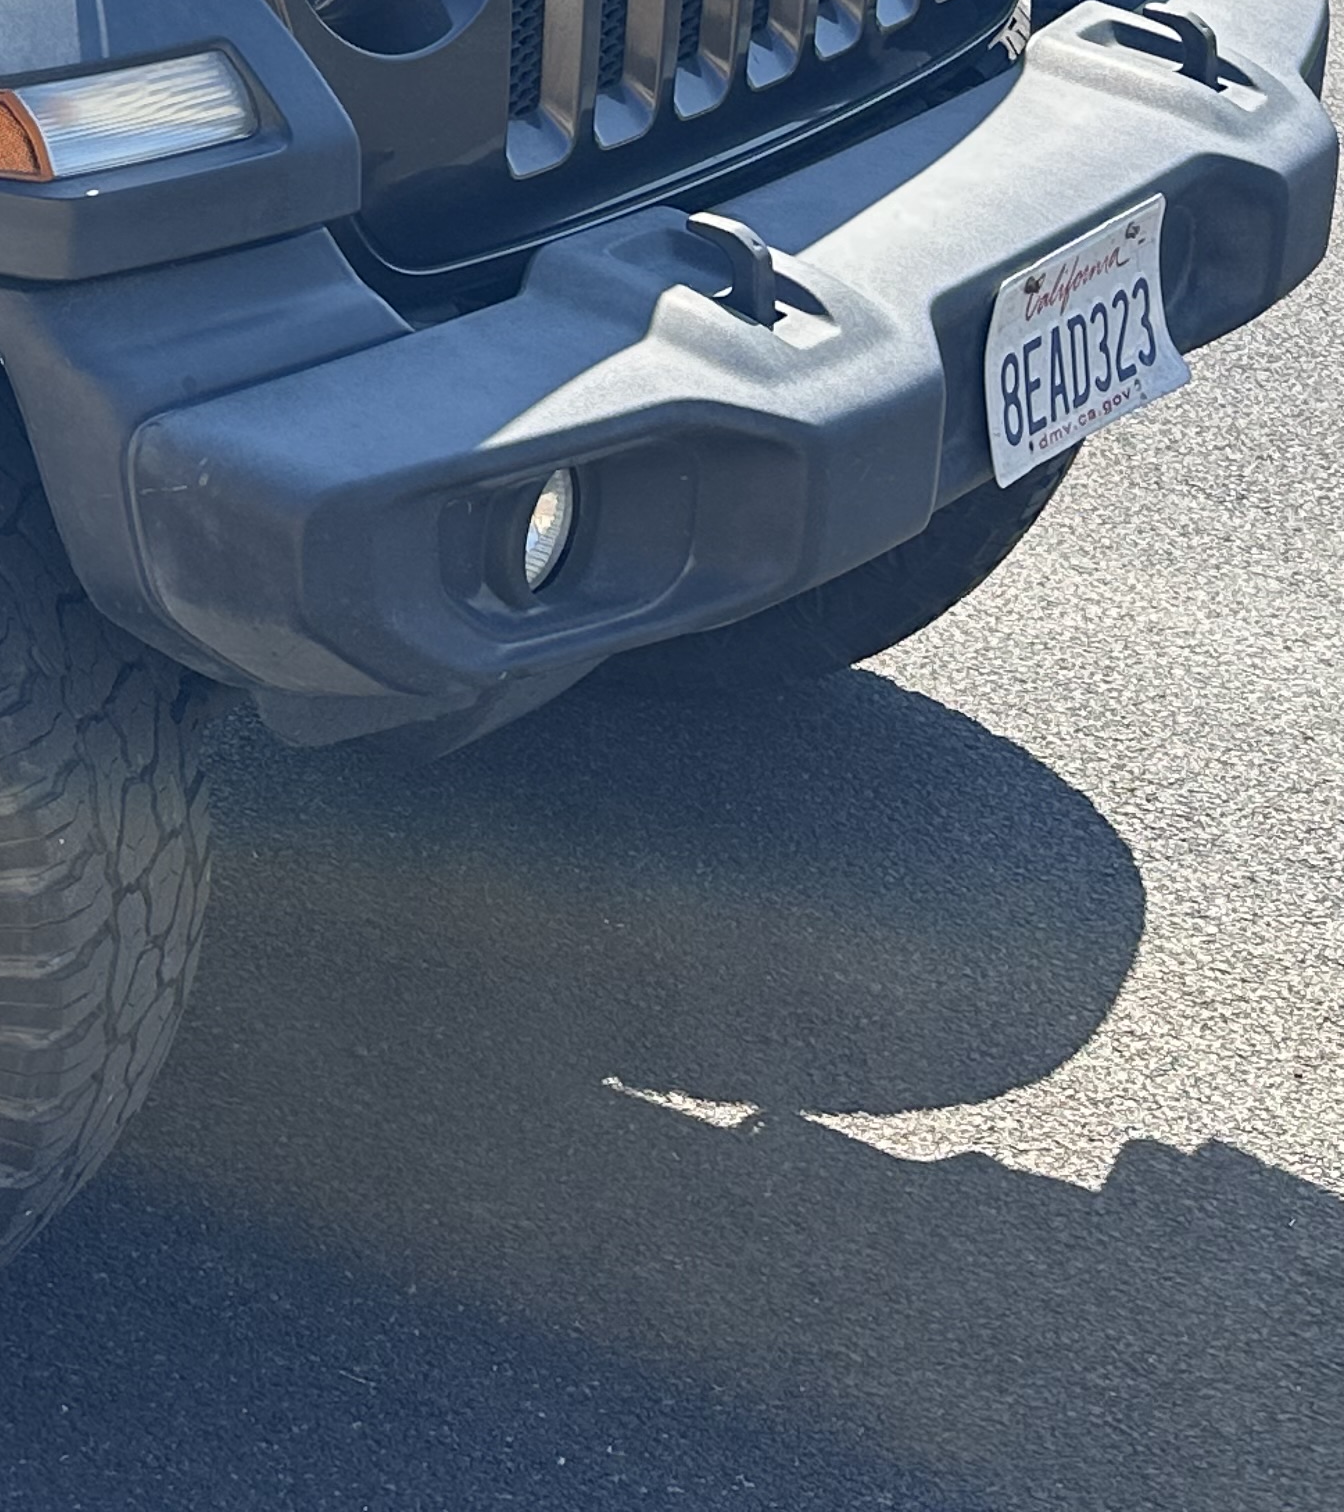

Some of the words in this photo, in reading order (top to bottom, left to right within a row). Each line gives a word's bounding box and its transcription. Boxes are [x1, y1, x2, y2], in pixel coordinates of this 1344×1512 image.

[1024, 246, 1131, 322] California
[1000, 276, 1157, 447] 8EAD323
[1038, 388, 1132, 451] dmv.ca.gov
